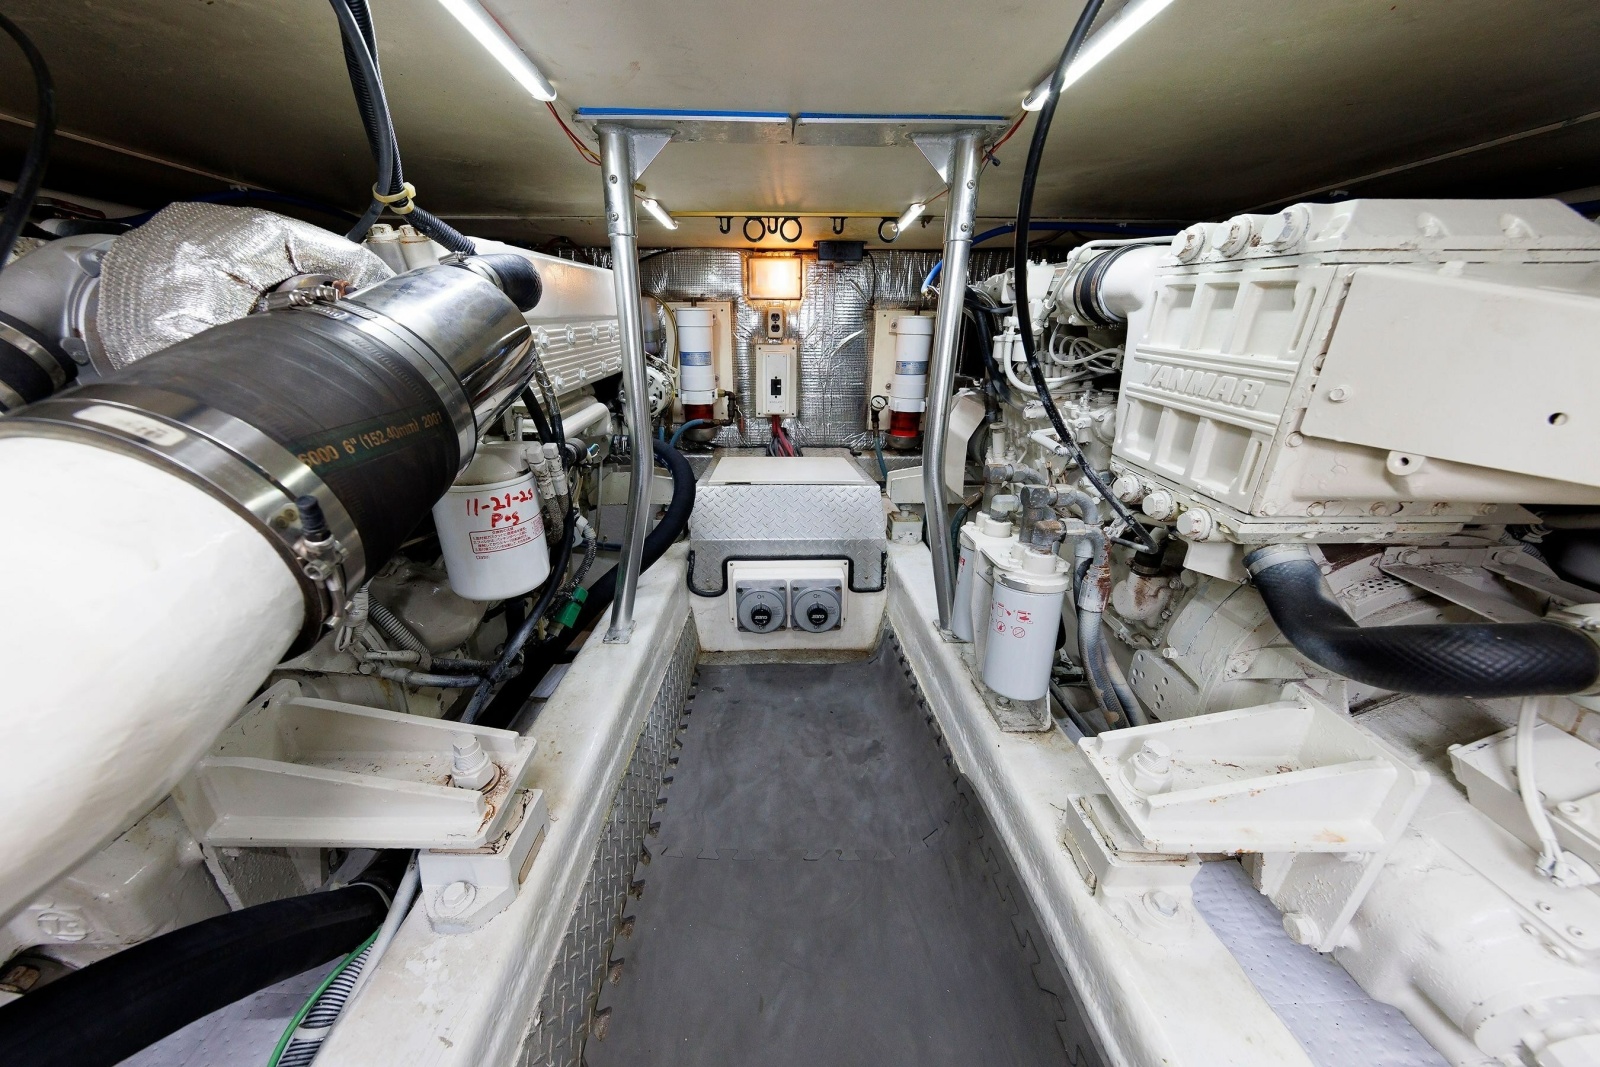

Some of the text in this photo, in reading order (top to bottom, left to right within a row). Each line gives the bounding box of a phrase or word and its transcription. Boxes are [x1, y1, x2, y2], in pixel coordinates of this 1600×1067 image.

[1143, 362, 1265, 407] YANMAR
[359, 418, 420, 449] (152.40mm)
[422, 411, 443, 428] 2001
